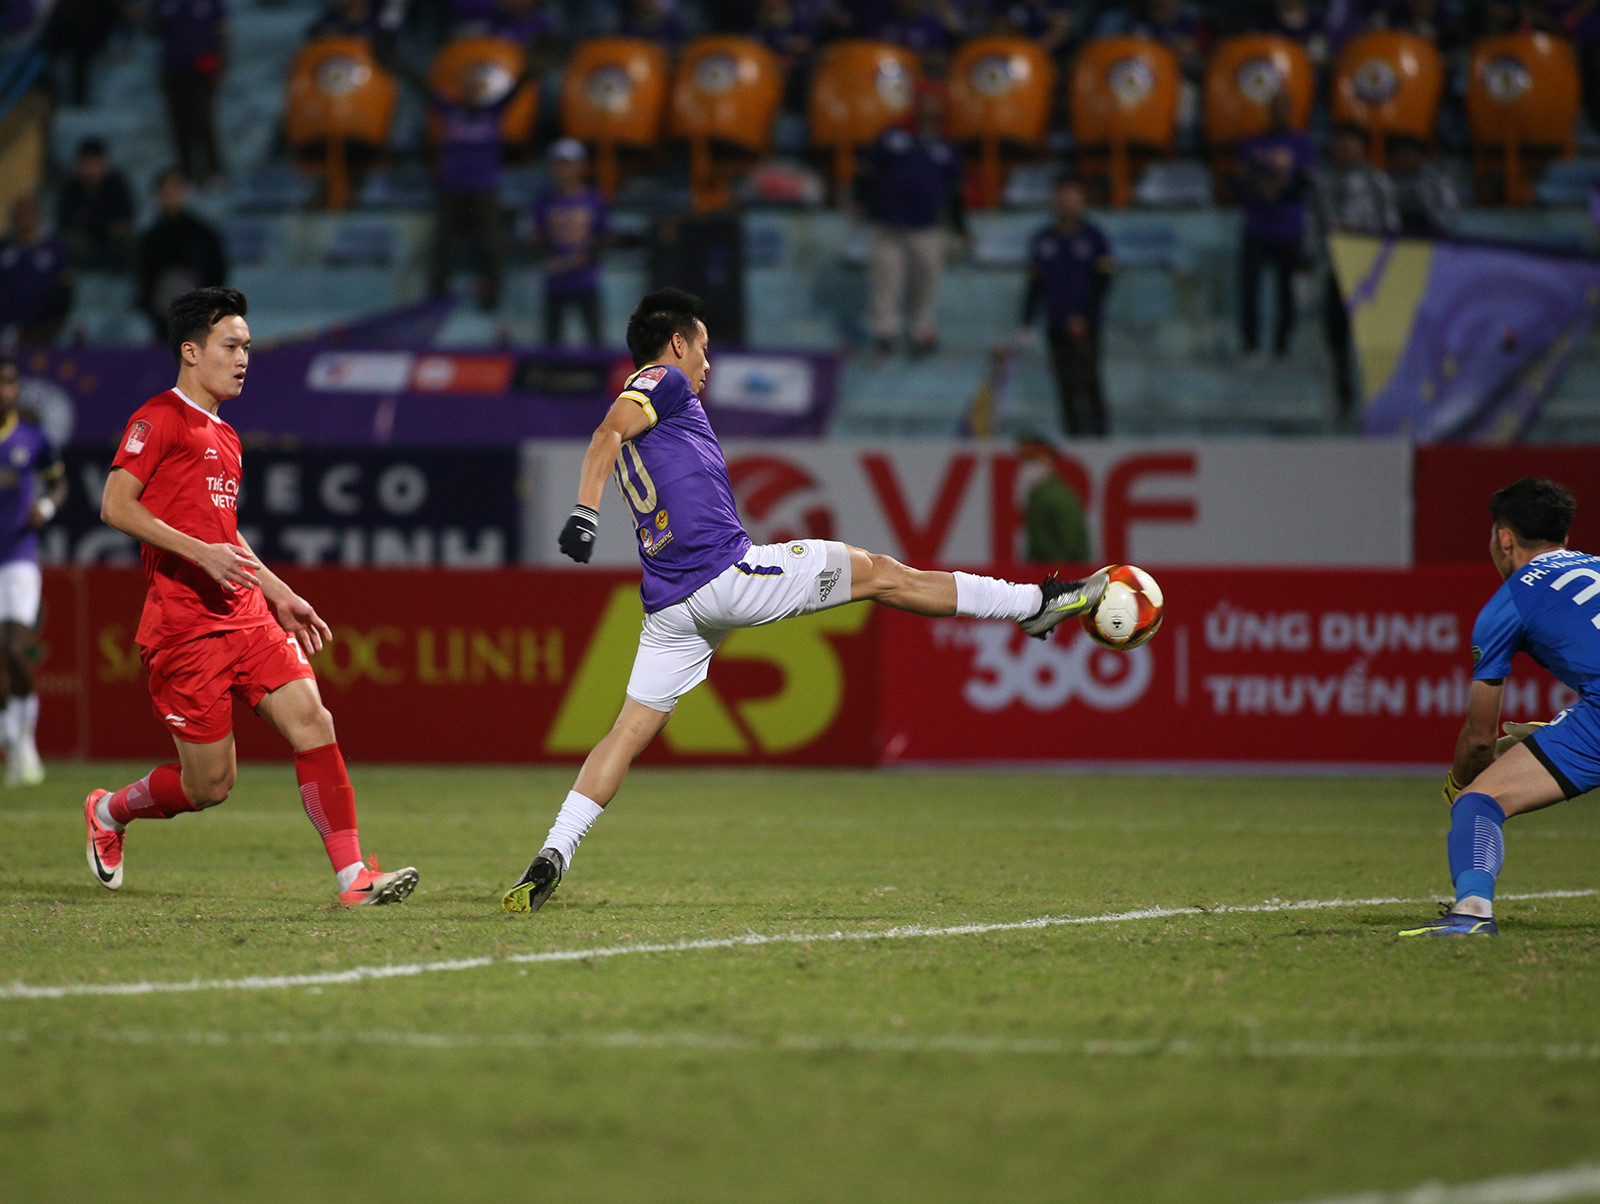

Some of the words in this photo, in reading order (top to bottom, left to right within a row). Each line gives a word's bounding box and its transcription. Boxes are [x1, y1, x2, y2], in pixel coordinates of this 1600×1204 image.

[820, 567, 842, 602] adidas
[415, 628, 565, 684] LINH
[1416, 666, 1537, 716] HÌH
